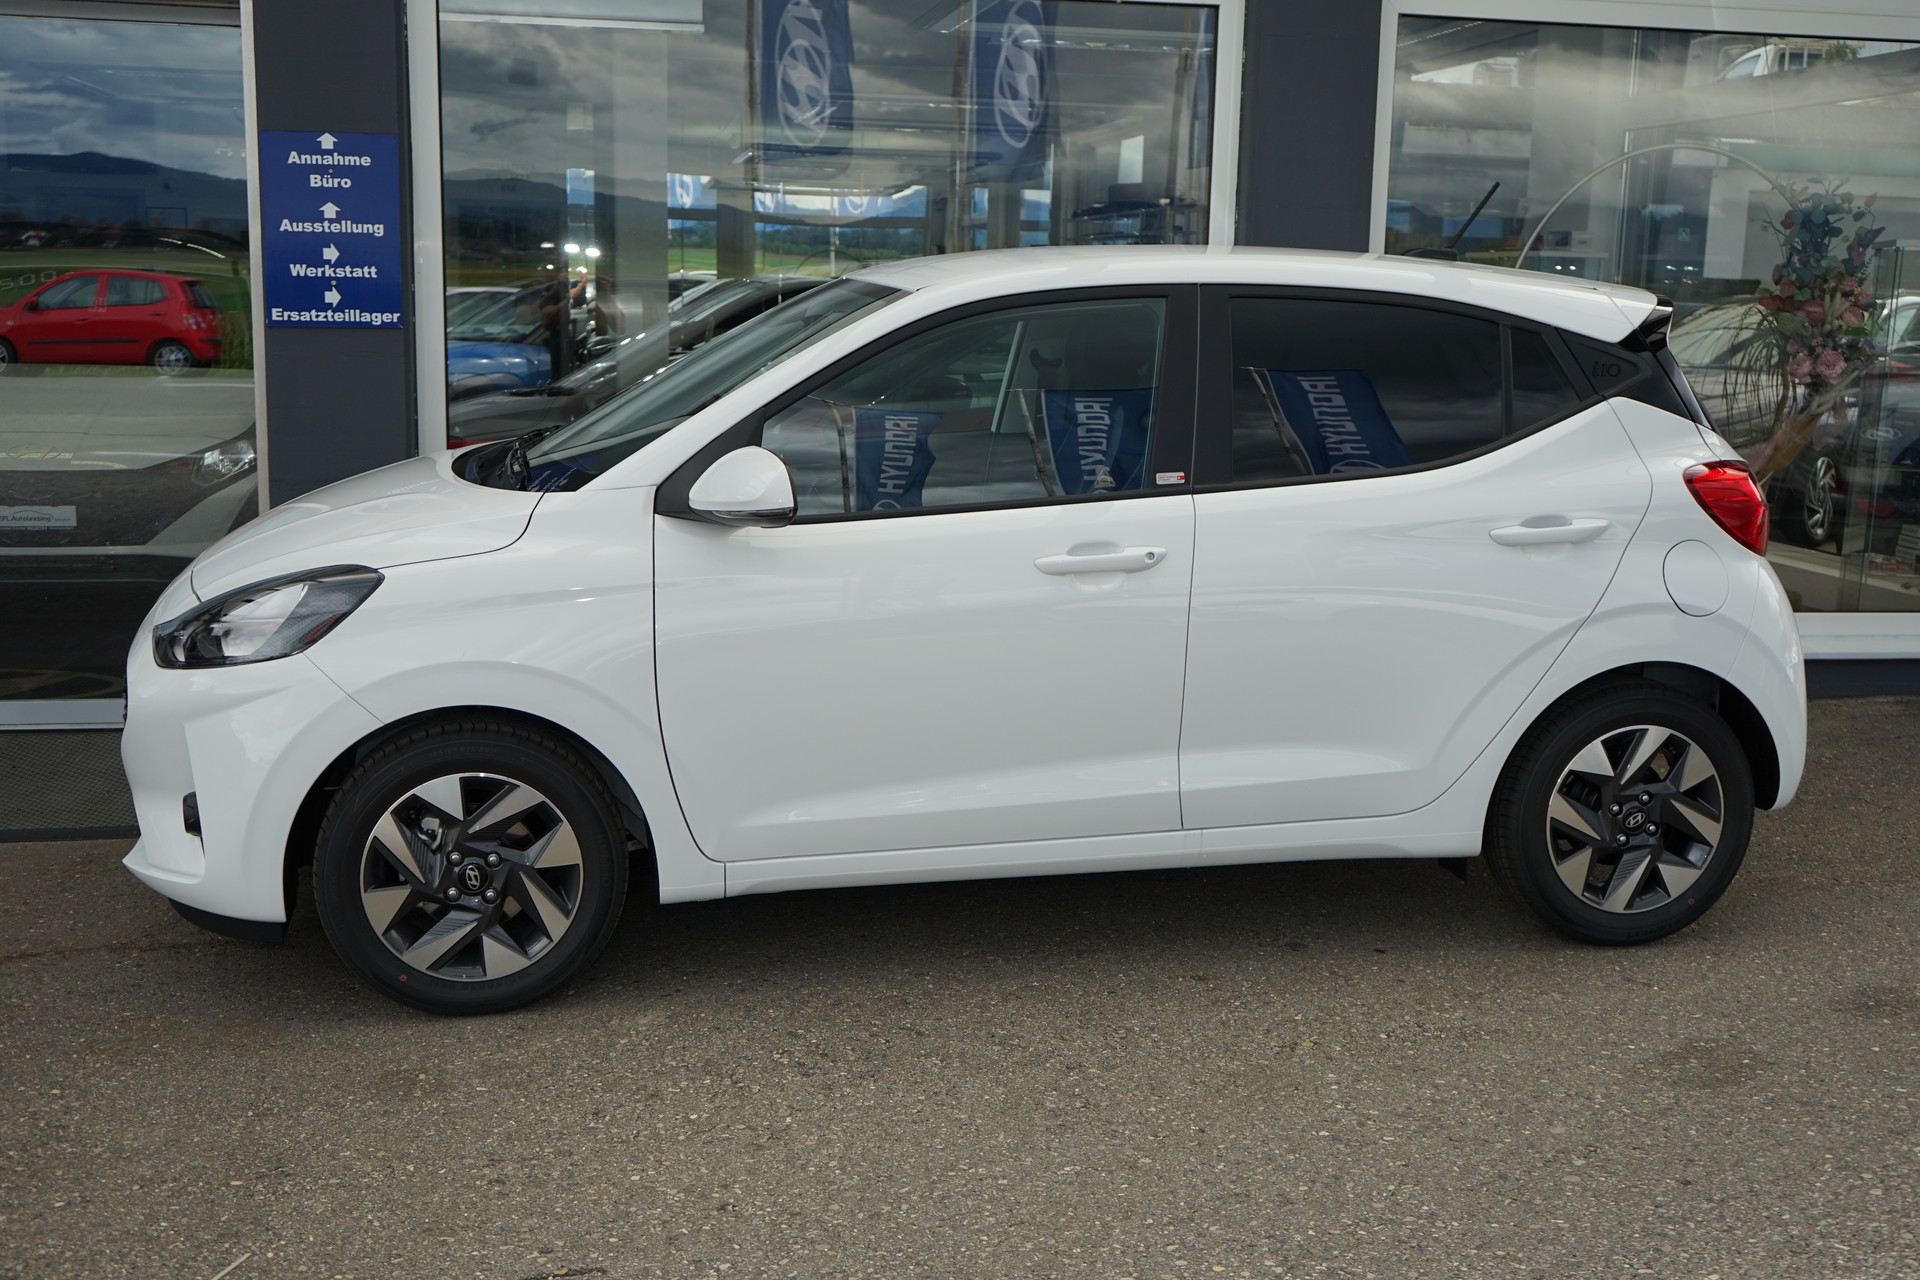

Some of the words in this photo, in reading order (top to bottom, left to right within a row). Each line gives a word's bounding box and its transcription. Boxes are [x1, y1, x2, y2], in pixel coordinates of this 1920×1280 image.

[287, 151, 372, 166] Annahme
[309, 174, 352, 188] Büro
[279, 218, 384, 237] Ausstellung
[289, 264, 378, 278] Werkstatt
[271, 307, 401, 325] Ersatzteillager
[1296, 376, 1371, 456] HYUNDAI
[1074, 397, 1114, 482] HYUNDAI
[876, 415, 919, 494] HYUNDAI
[11, 515, 52, 523] Autoleasing
